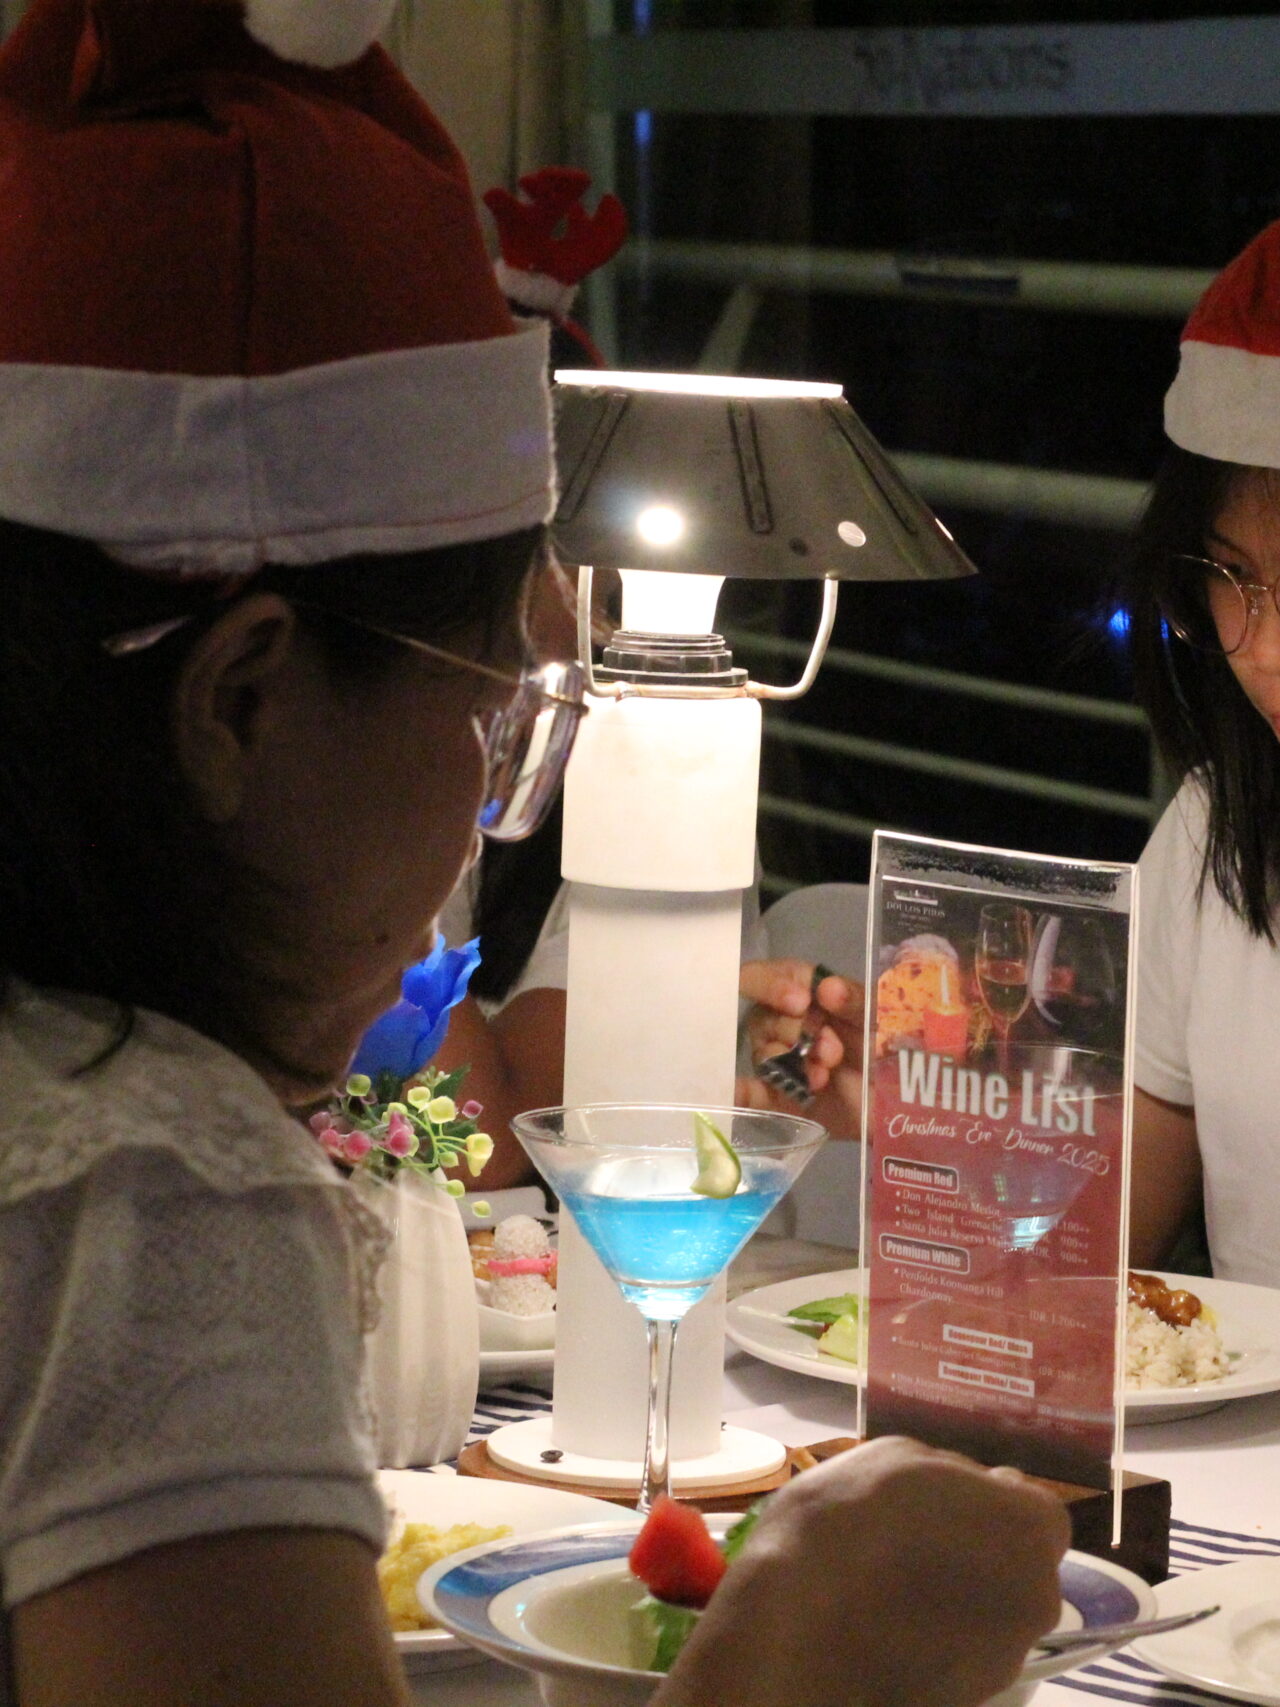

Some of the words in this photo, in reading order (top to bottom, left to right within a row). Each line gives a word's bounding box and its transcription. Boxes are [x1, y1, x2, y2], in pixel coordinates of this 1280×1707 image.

[897, 1048, 1009, 1121] Wine
[1020, 1069, 1097, 1138] List
[885, 1113, 957, 1139] Christmas
[960, 1119, 996, 1146] Eve
[1001, 1127, 1054, 1155] Dinner
[1056, 1142, 1111, 1177] 2025
[887, 1162, 932, 1185] Premium
[933, 1170, 954, 1188] Red
[902, 1188, 922, 1202] Don
[924, 1192, 968, 1211] Alejandro
[902, 1204, 921, 1217] Two
[926, 1210, 954, 1224] Island
[901, 1219, 926, 1234] Santa
[927, 1223, 948, 1238] Julia
[886, 1240, 930, 1260] Premium
[931, 1249, 962, 1268] White
[899, 1268, 938, 1286] Penfolds
